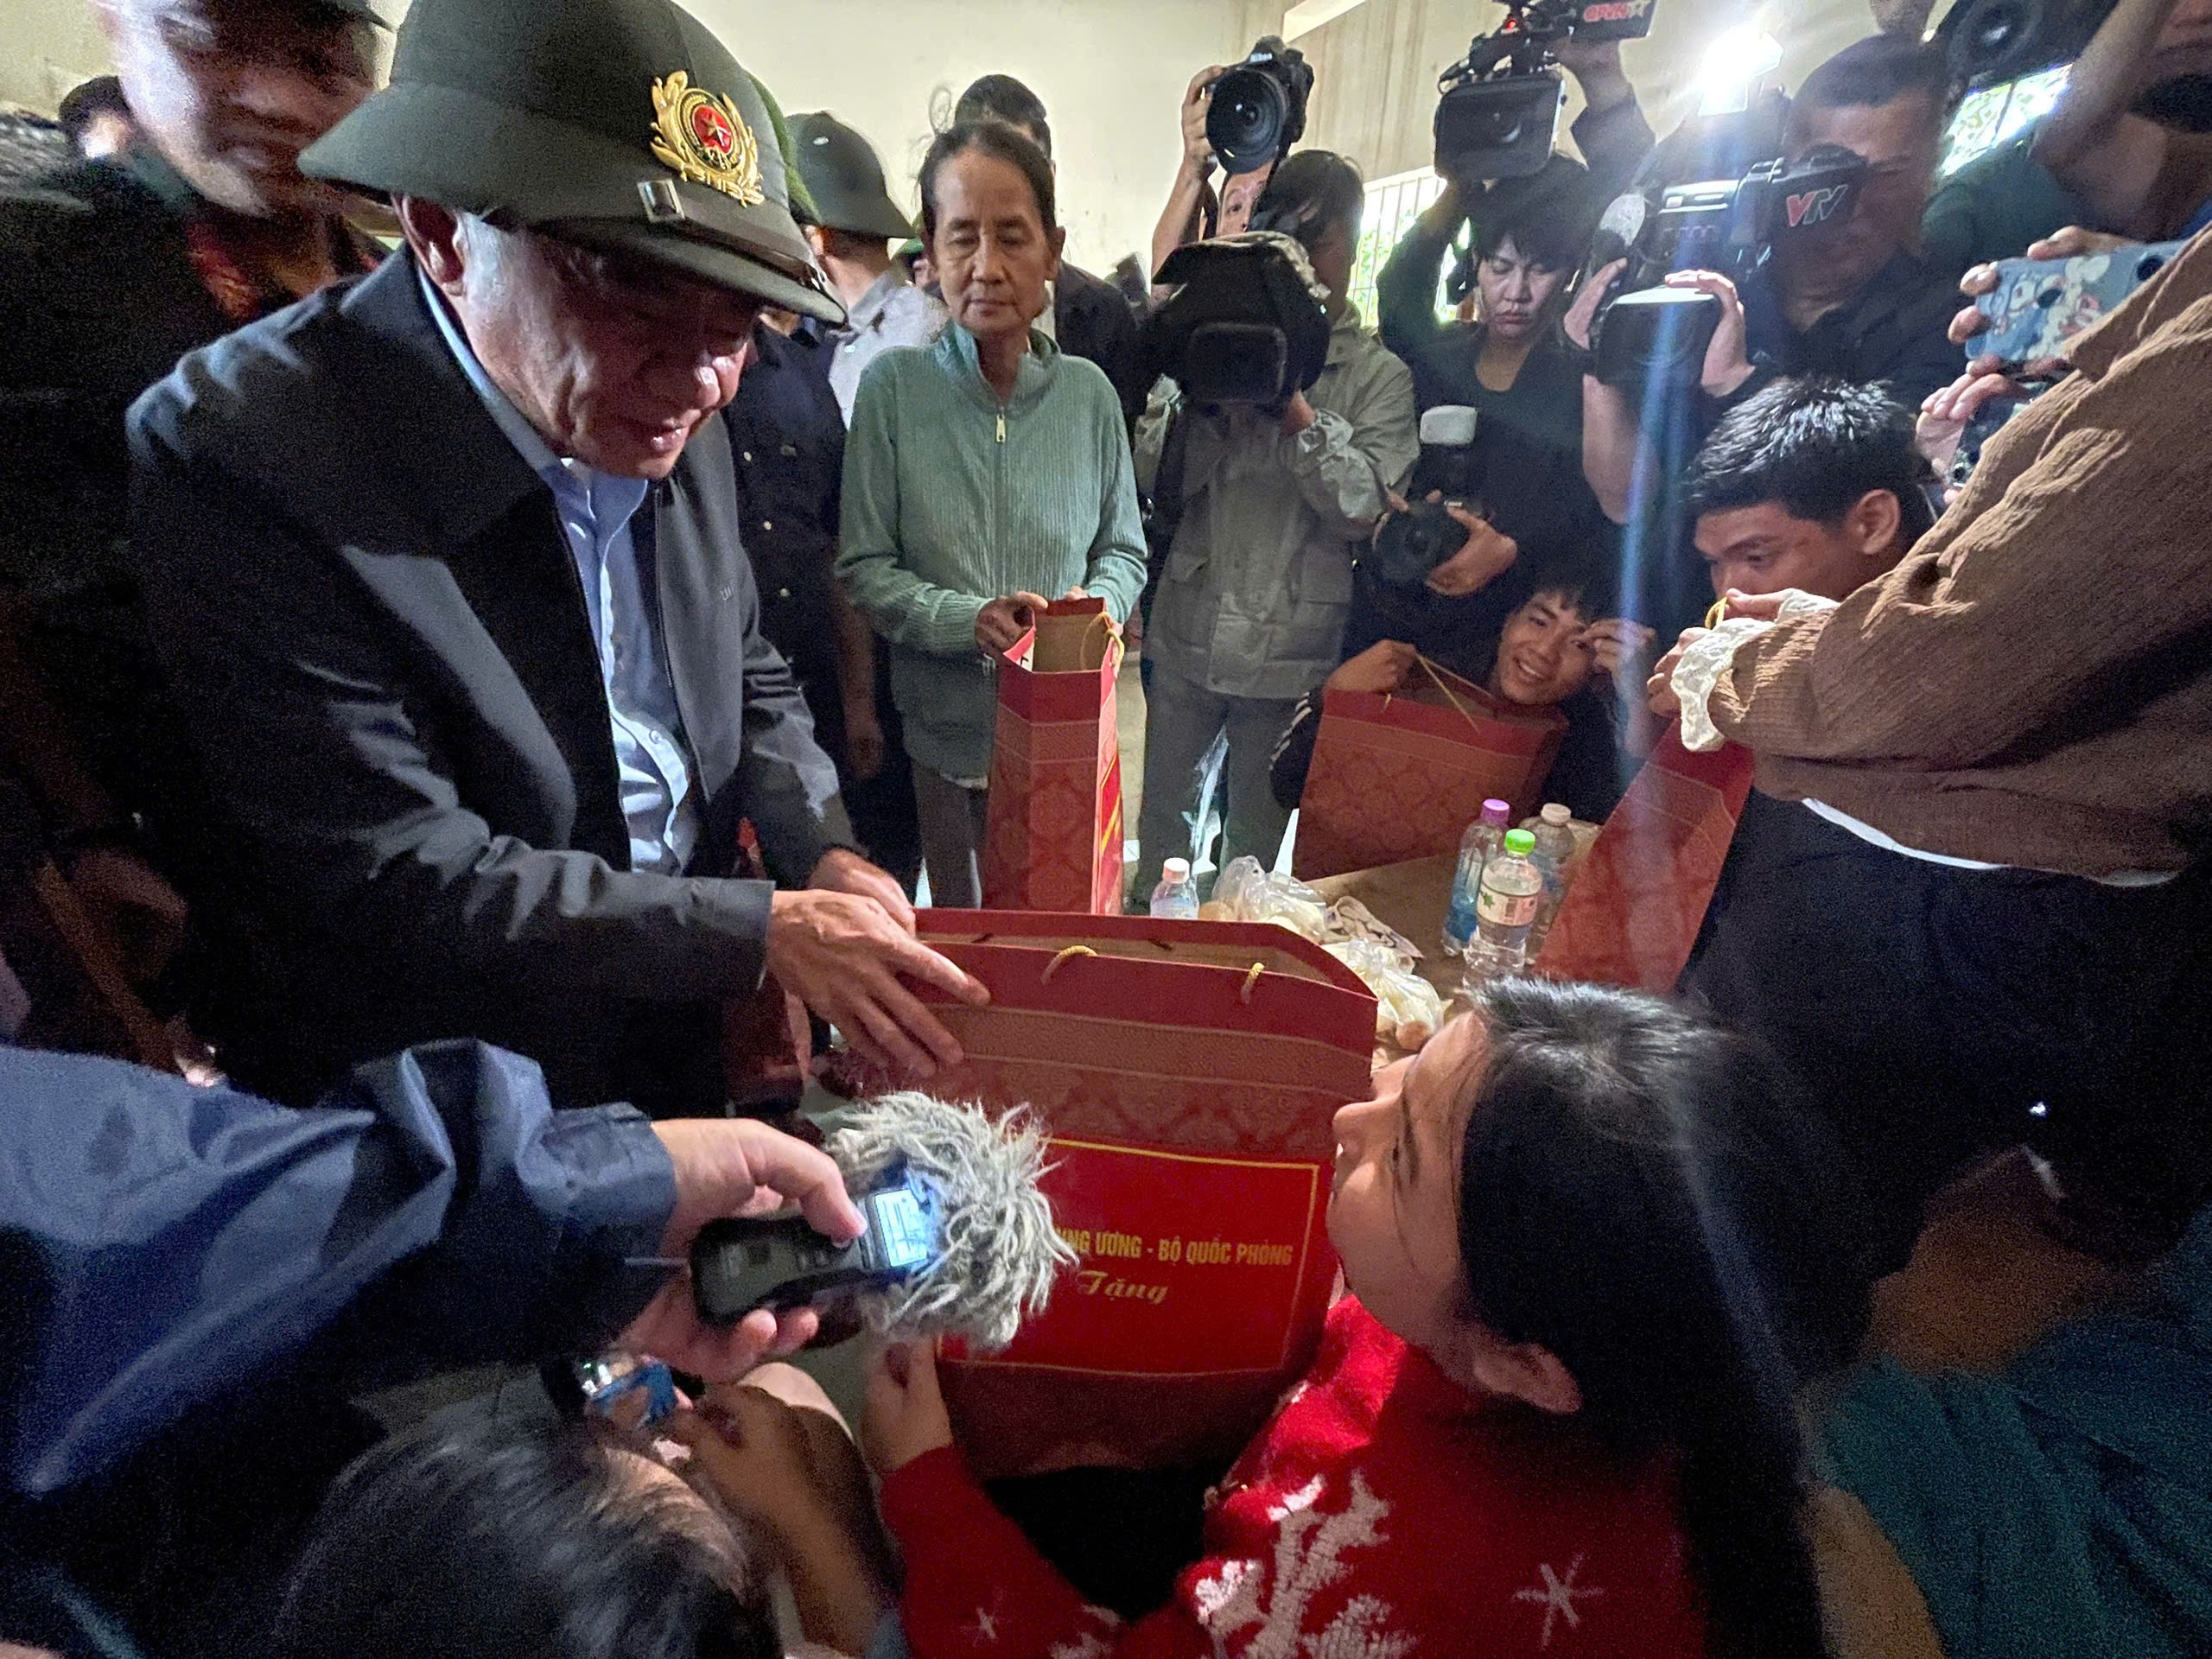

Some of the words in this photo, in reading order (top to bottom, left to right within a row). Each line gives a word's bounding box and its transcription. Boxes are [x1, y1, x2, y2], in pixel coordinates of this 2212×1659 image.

[1786, 184, 1848, 227] VTV
[1158, 1236, 1181, 1266] BỘ
[1185, 1234, 1232, 1265] QUỐC
[1075, 1270, 1168, 1305] Tặng
